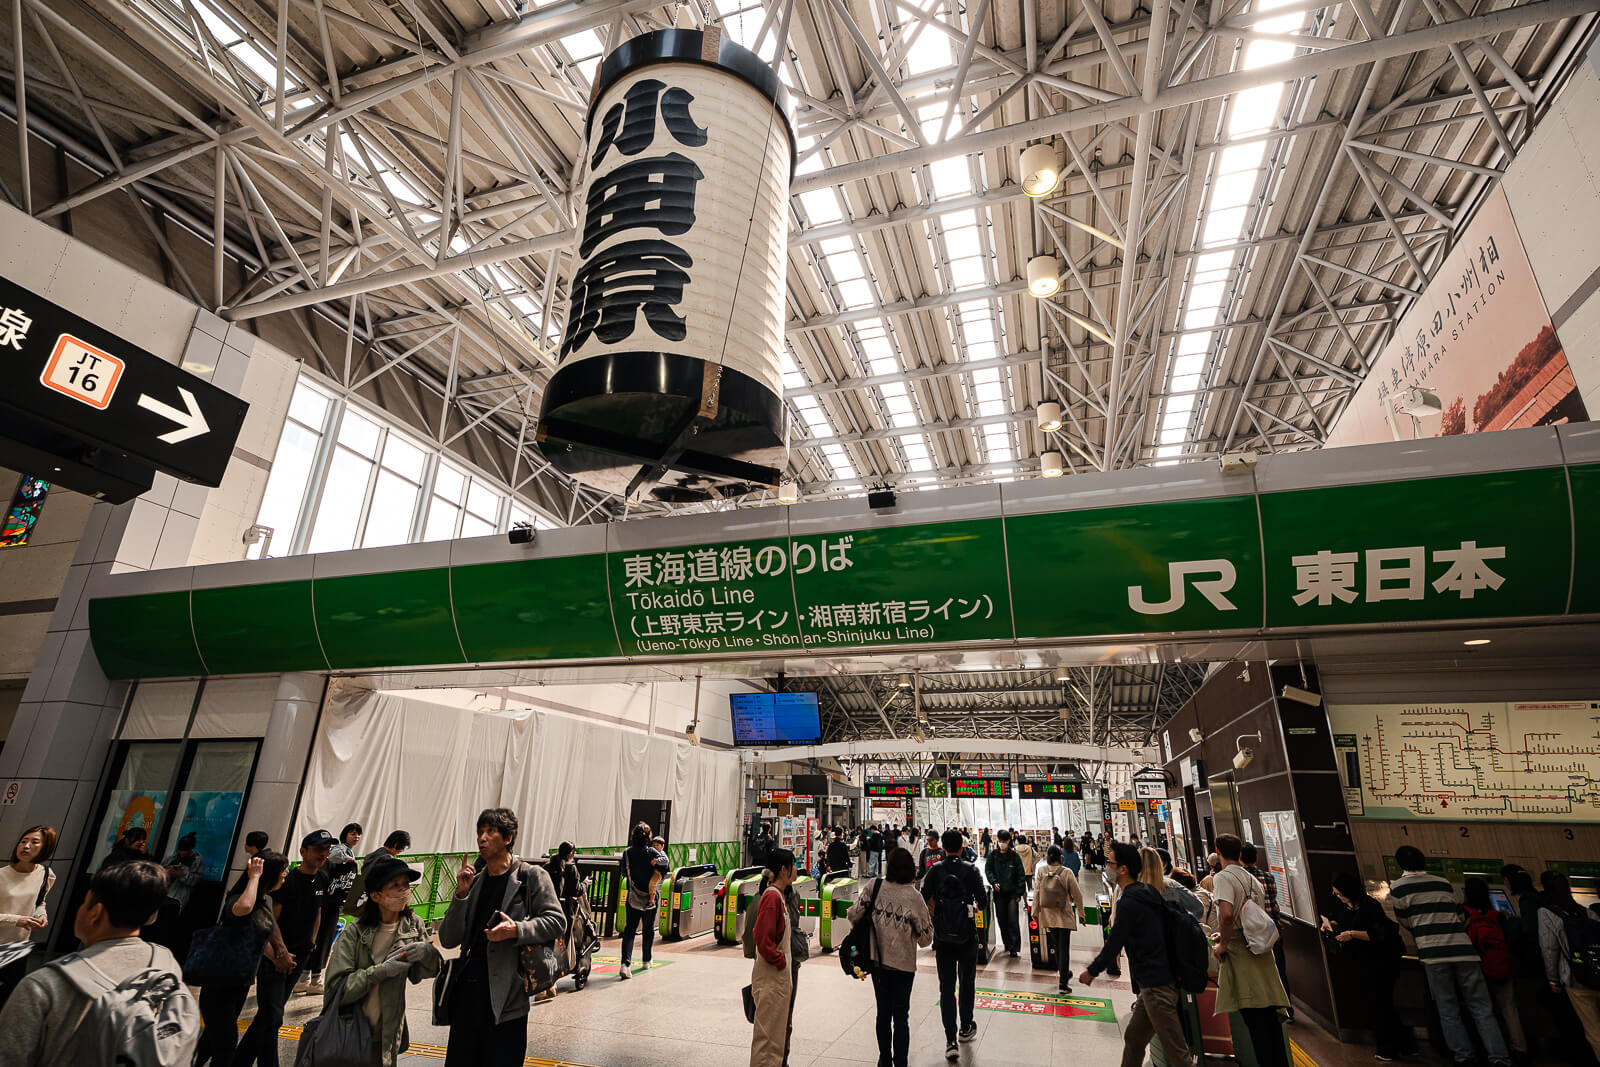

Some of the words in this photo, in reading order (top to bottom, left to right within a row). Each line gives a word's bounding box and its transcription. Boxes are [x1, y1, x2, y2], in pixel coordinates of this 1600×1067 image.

[559, 79, 708, 364] 小田原
[1452, 270, 1505, 340] STATION
[76, 352, 102, 370] JT
[68, 366, 99, 392] 16
[623, 535, 854, 588] 東海道線のりば
[1127, 558, 1238, 615] JR
[1292, 540, 1506, 606] 東日本
[626, 589, 705, 610] Tōkaidō
[711, 586, 755, 605] Line
[896, 624, 935, 640] Line)
[1401, 825, 1408, 837] 1
[1459, 826, 1470, 838] 2
[1564, 828, 1575, 841] 3
